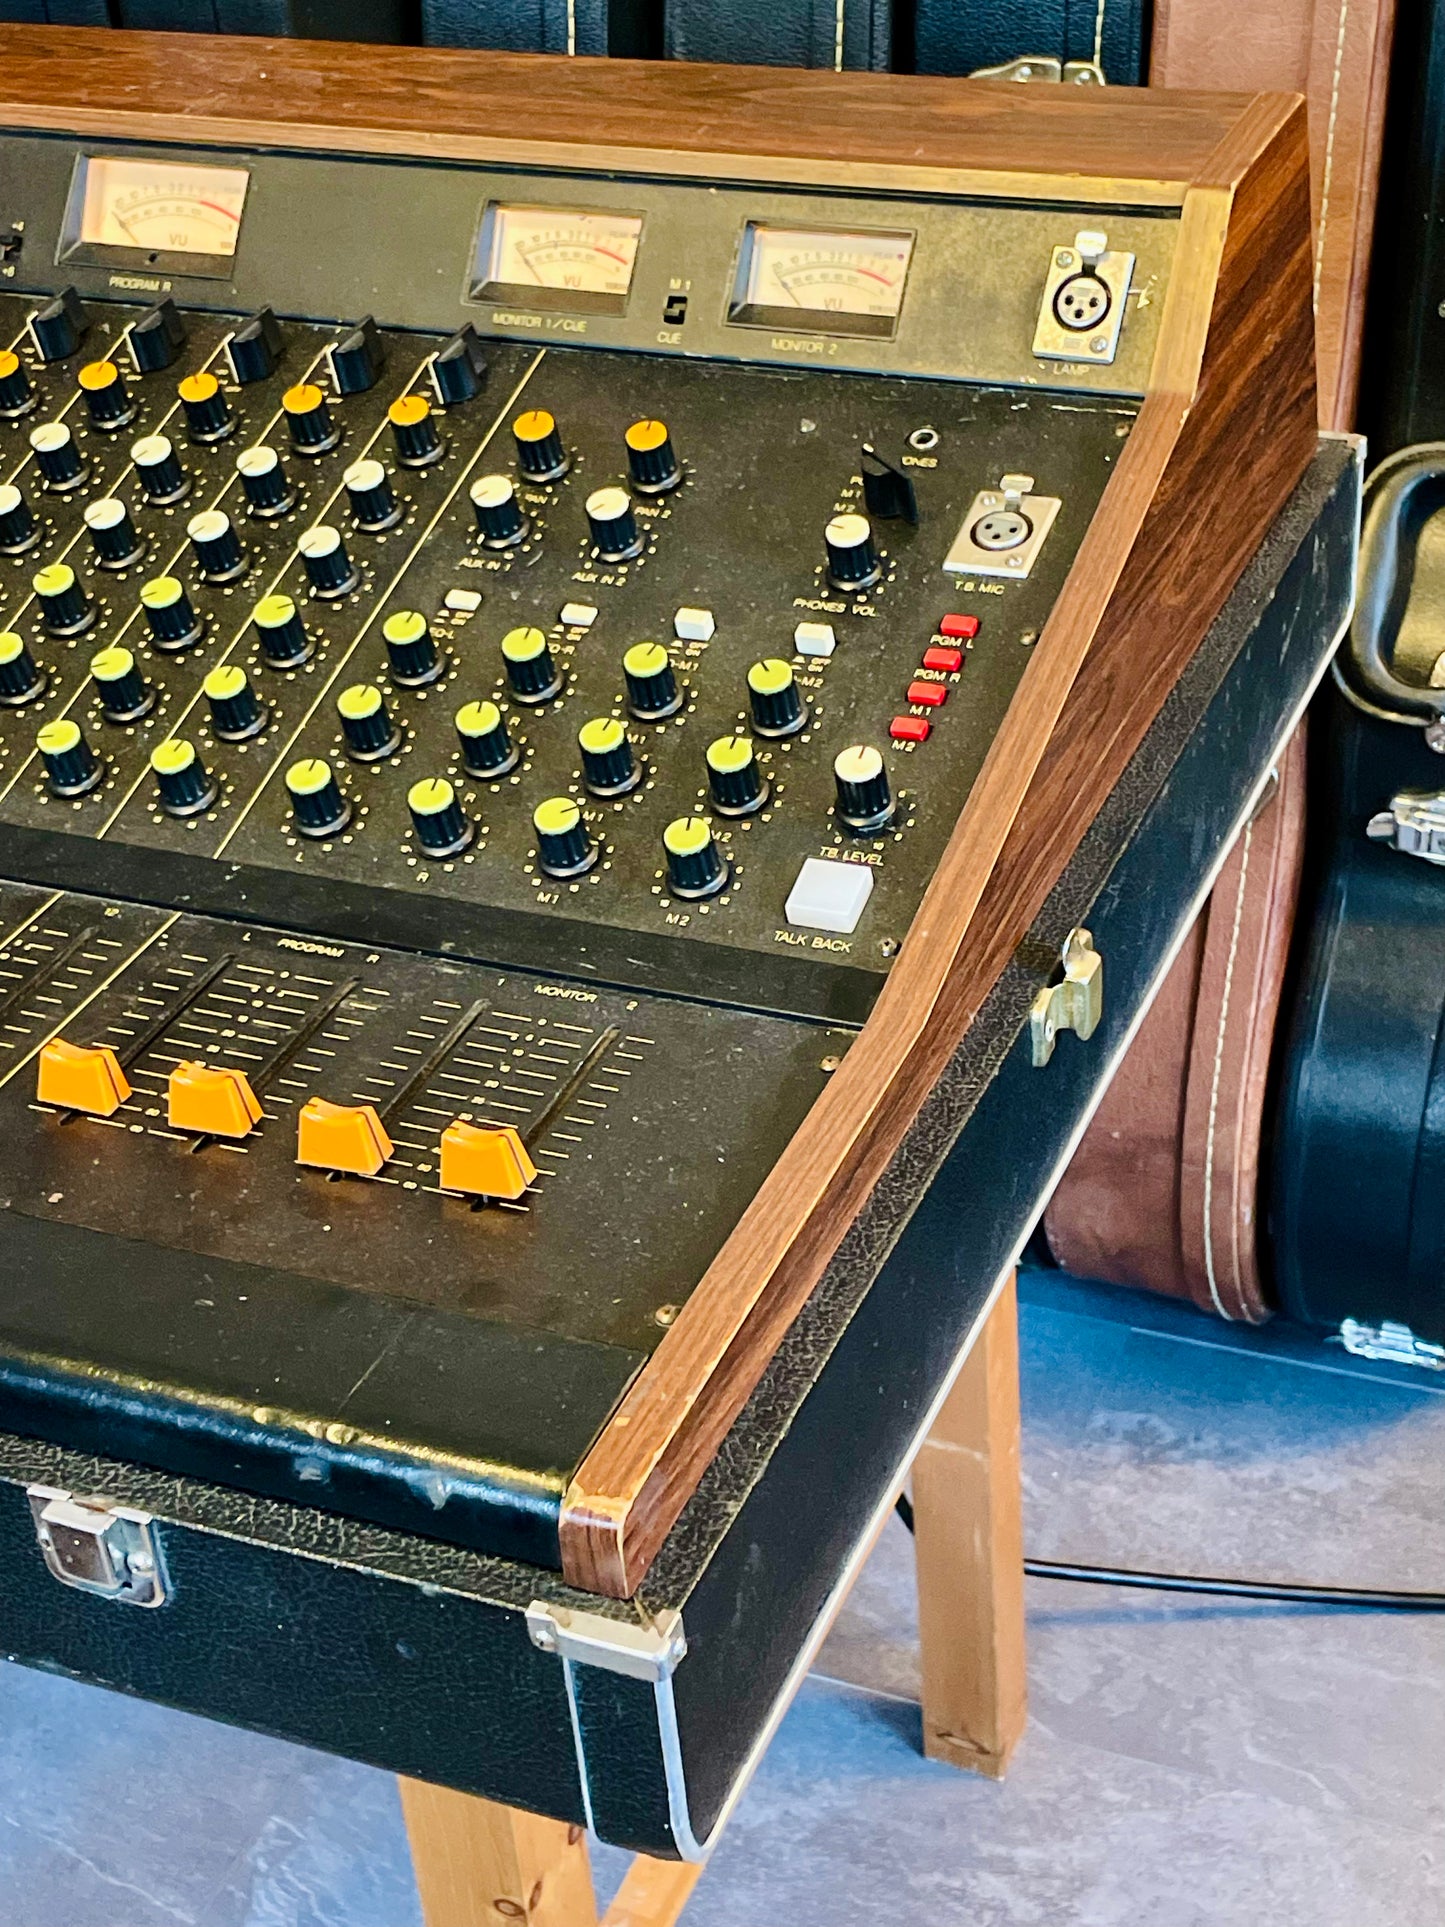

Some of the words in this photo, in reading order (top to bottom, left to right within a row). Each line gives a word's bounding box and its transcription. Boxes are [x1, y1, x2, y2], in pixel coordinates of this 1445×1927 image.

[169, 233, 188, 247] VU
[109, 275, 160, 291] PROGRAM
[162, 281, 172, 292] R
[563, 275, 582, 288] VU
[824, 297, 843, 310] VU
[492, 312, 541, 327] MONITOR
[656, 331, 682, 344] CUE
[771, 338, 824, 353] MONITOR
[828, 343, 838, 355] 2
[1052, 363, 1090, 375] LAMP
[634, 506, 660, 517] PAN
[661, 509, 672, 519] 2
[833, 502, 856, 513] M2
[459, 557, 483, 569] AUX
[486, 560, 501, 570] IN
[571, 572, 599, 583] AUX
[600, 575, 614, 585] IN
[615, 577, 627, 587] 2
[978, 583, 1005, 596] MIC
[793, 598, 847, 614] PHONES
[930, 634, 963, 647] PGM
[966, 639, 974, 649] L
[913, 668, 945, 681] PGM
[949, 673, 961, 683] R
[909, 705, 932, 717] M1
[891, 740, 916, 753] M2
[582, 810, 604, 823] M1
[842, 850, 884, 866] LEVEL
[417, 871, 430, 883] R
[536, 891, 560, 905] M1
[665, 913, 692, 926] M2
[773, 930, 808, 945] TALK
[811, 936, 853, 953] BACK
[277, 938, 345, 958] PROGRAM
[366, 953, 380, 964] R
[533, 984, 598, 1003] MONITOR
[625, 1001, 638, 1011] 2
